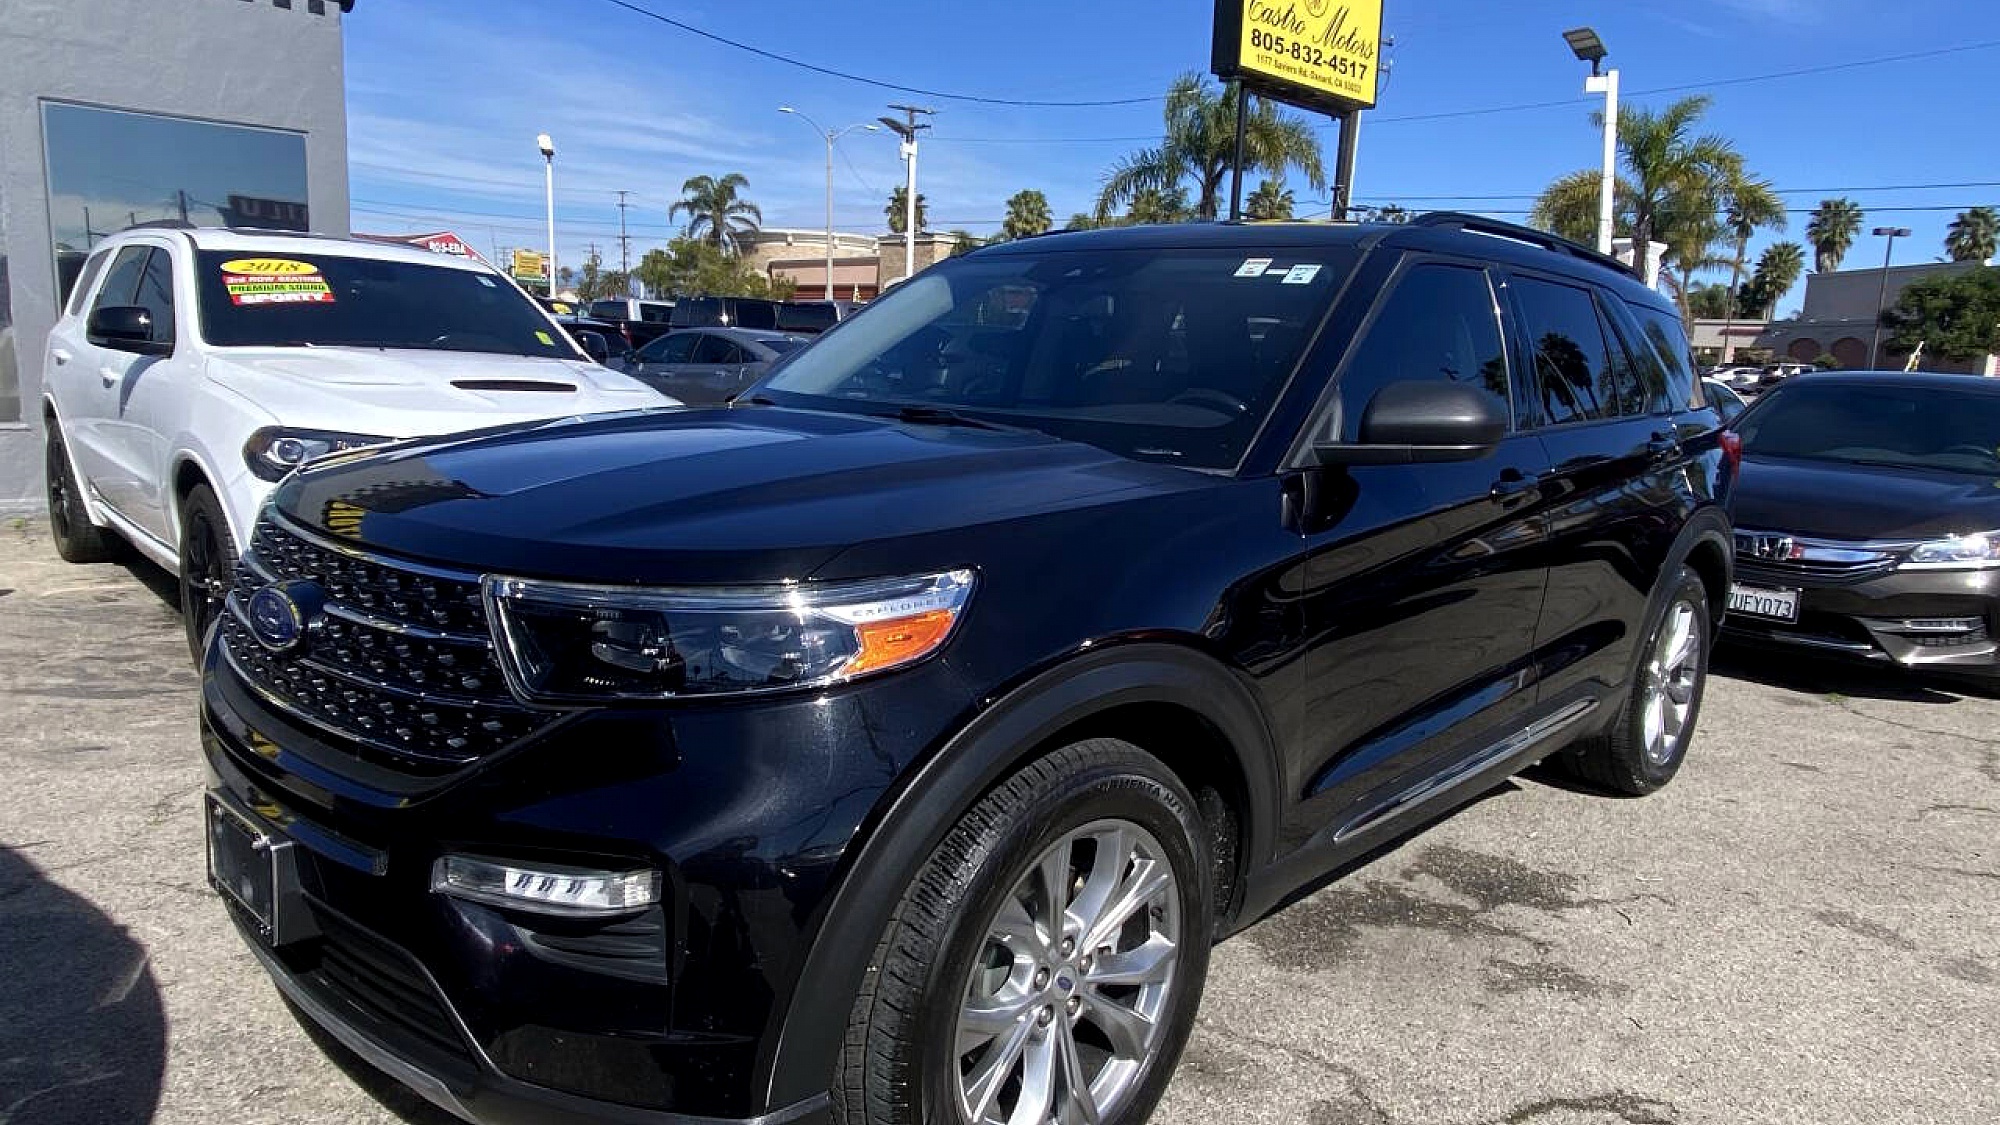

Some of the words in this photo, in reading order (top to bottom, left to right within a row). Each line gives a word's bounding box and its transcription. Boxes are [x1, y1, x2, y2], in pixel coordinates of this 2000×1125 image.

[1249, 0, 1306, 35] Castro
[1312, 5, 1374, 59] Motors
[1251, 28, 1367, 80] 805-832-4517
[240, 262, 301, 272] 2018
[231, 284, 286, 292] PREMIUM
[288, 284, 326, 292] SOUND
